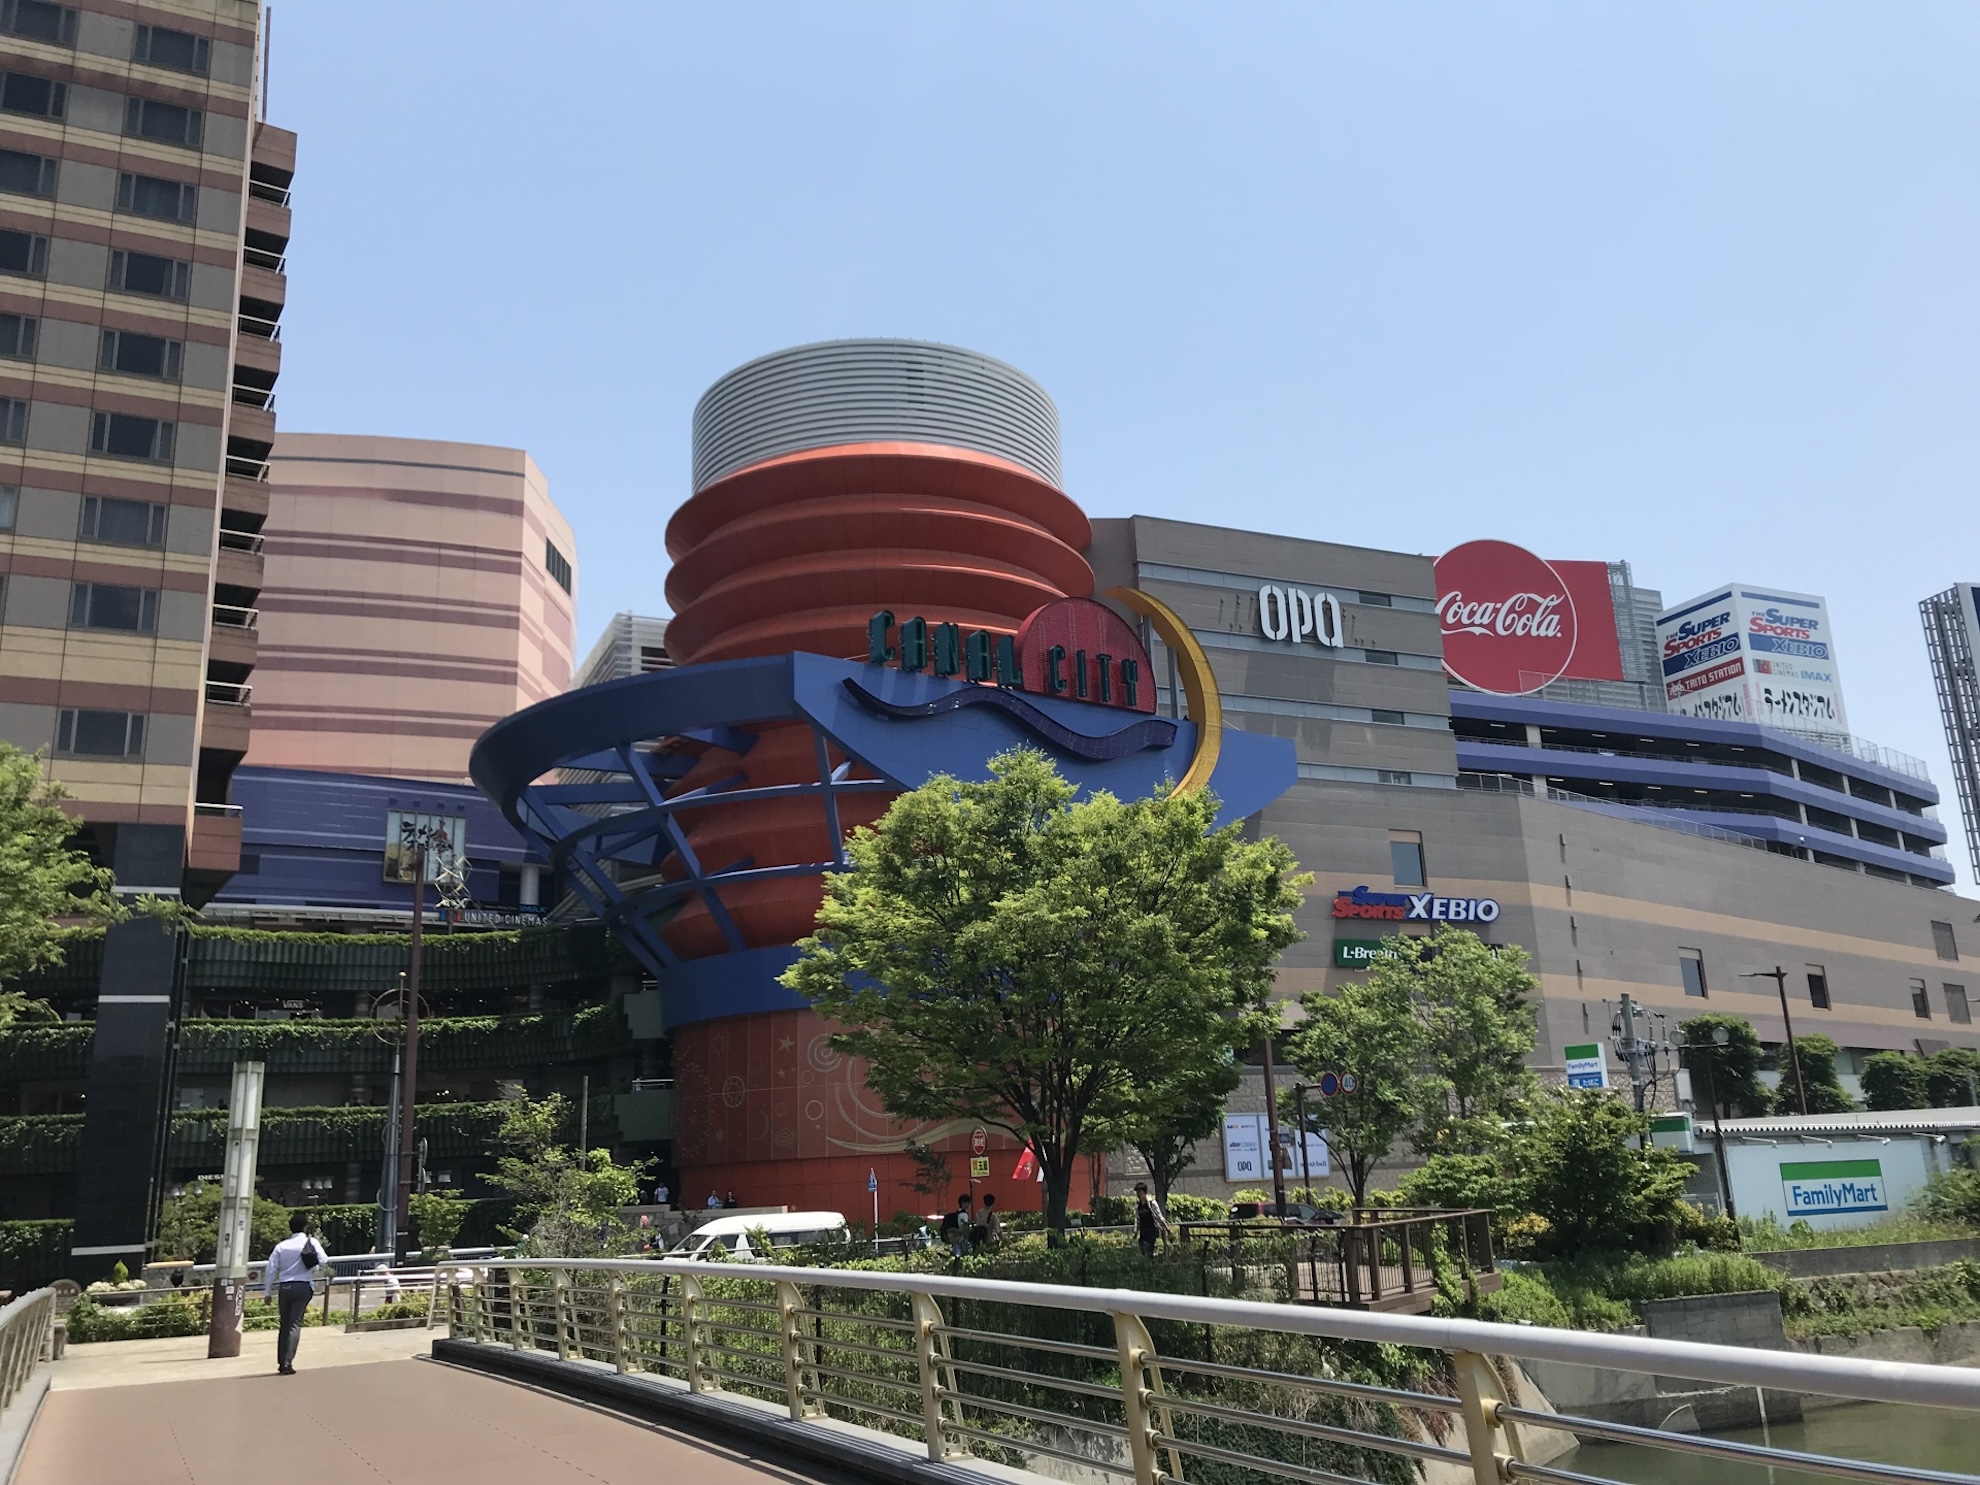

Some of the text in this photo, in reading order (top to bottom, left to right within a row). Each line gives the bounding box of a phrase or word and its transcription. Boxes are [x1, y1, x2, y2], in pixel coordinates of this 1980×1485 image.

[1435, 591, 1565, 637] Coca-Cola
[1765, 608, 1819, 630] SUPER
[1666, 612, 1731, 640] THE SUPER
[1749, 617, 1810, 639] SPORTS
[1664, 627, 1722, 658] SPORTS
[1684, 637, 1739, 669] XEBIO
[1772, 638, 1827, 659] XEBIO
[868, 609, 1138, 706] CANAL CITY
[1685, 662, 1742, 690] TAITO STATION
[1801, 670, 1832, 682] IMAX
[1332, 893, 1500, 921] SPORTS XEBIO
[464, 911, 548, 927] UNITED CINEMAS
[282, 999, 304, 1009] VANS
[1568, 1061, 1599, 1071] FamilyMart
[1582, 1078, 1600, 1087] たばこ
[1792, 1182, 1878, 1207] FamilyMart
